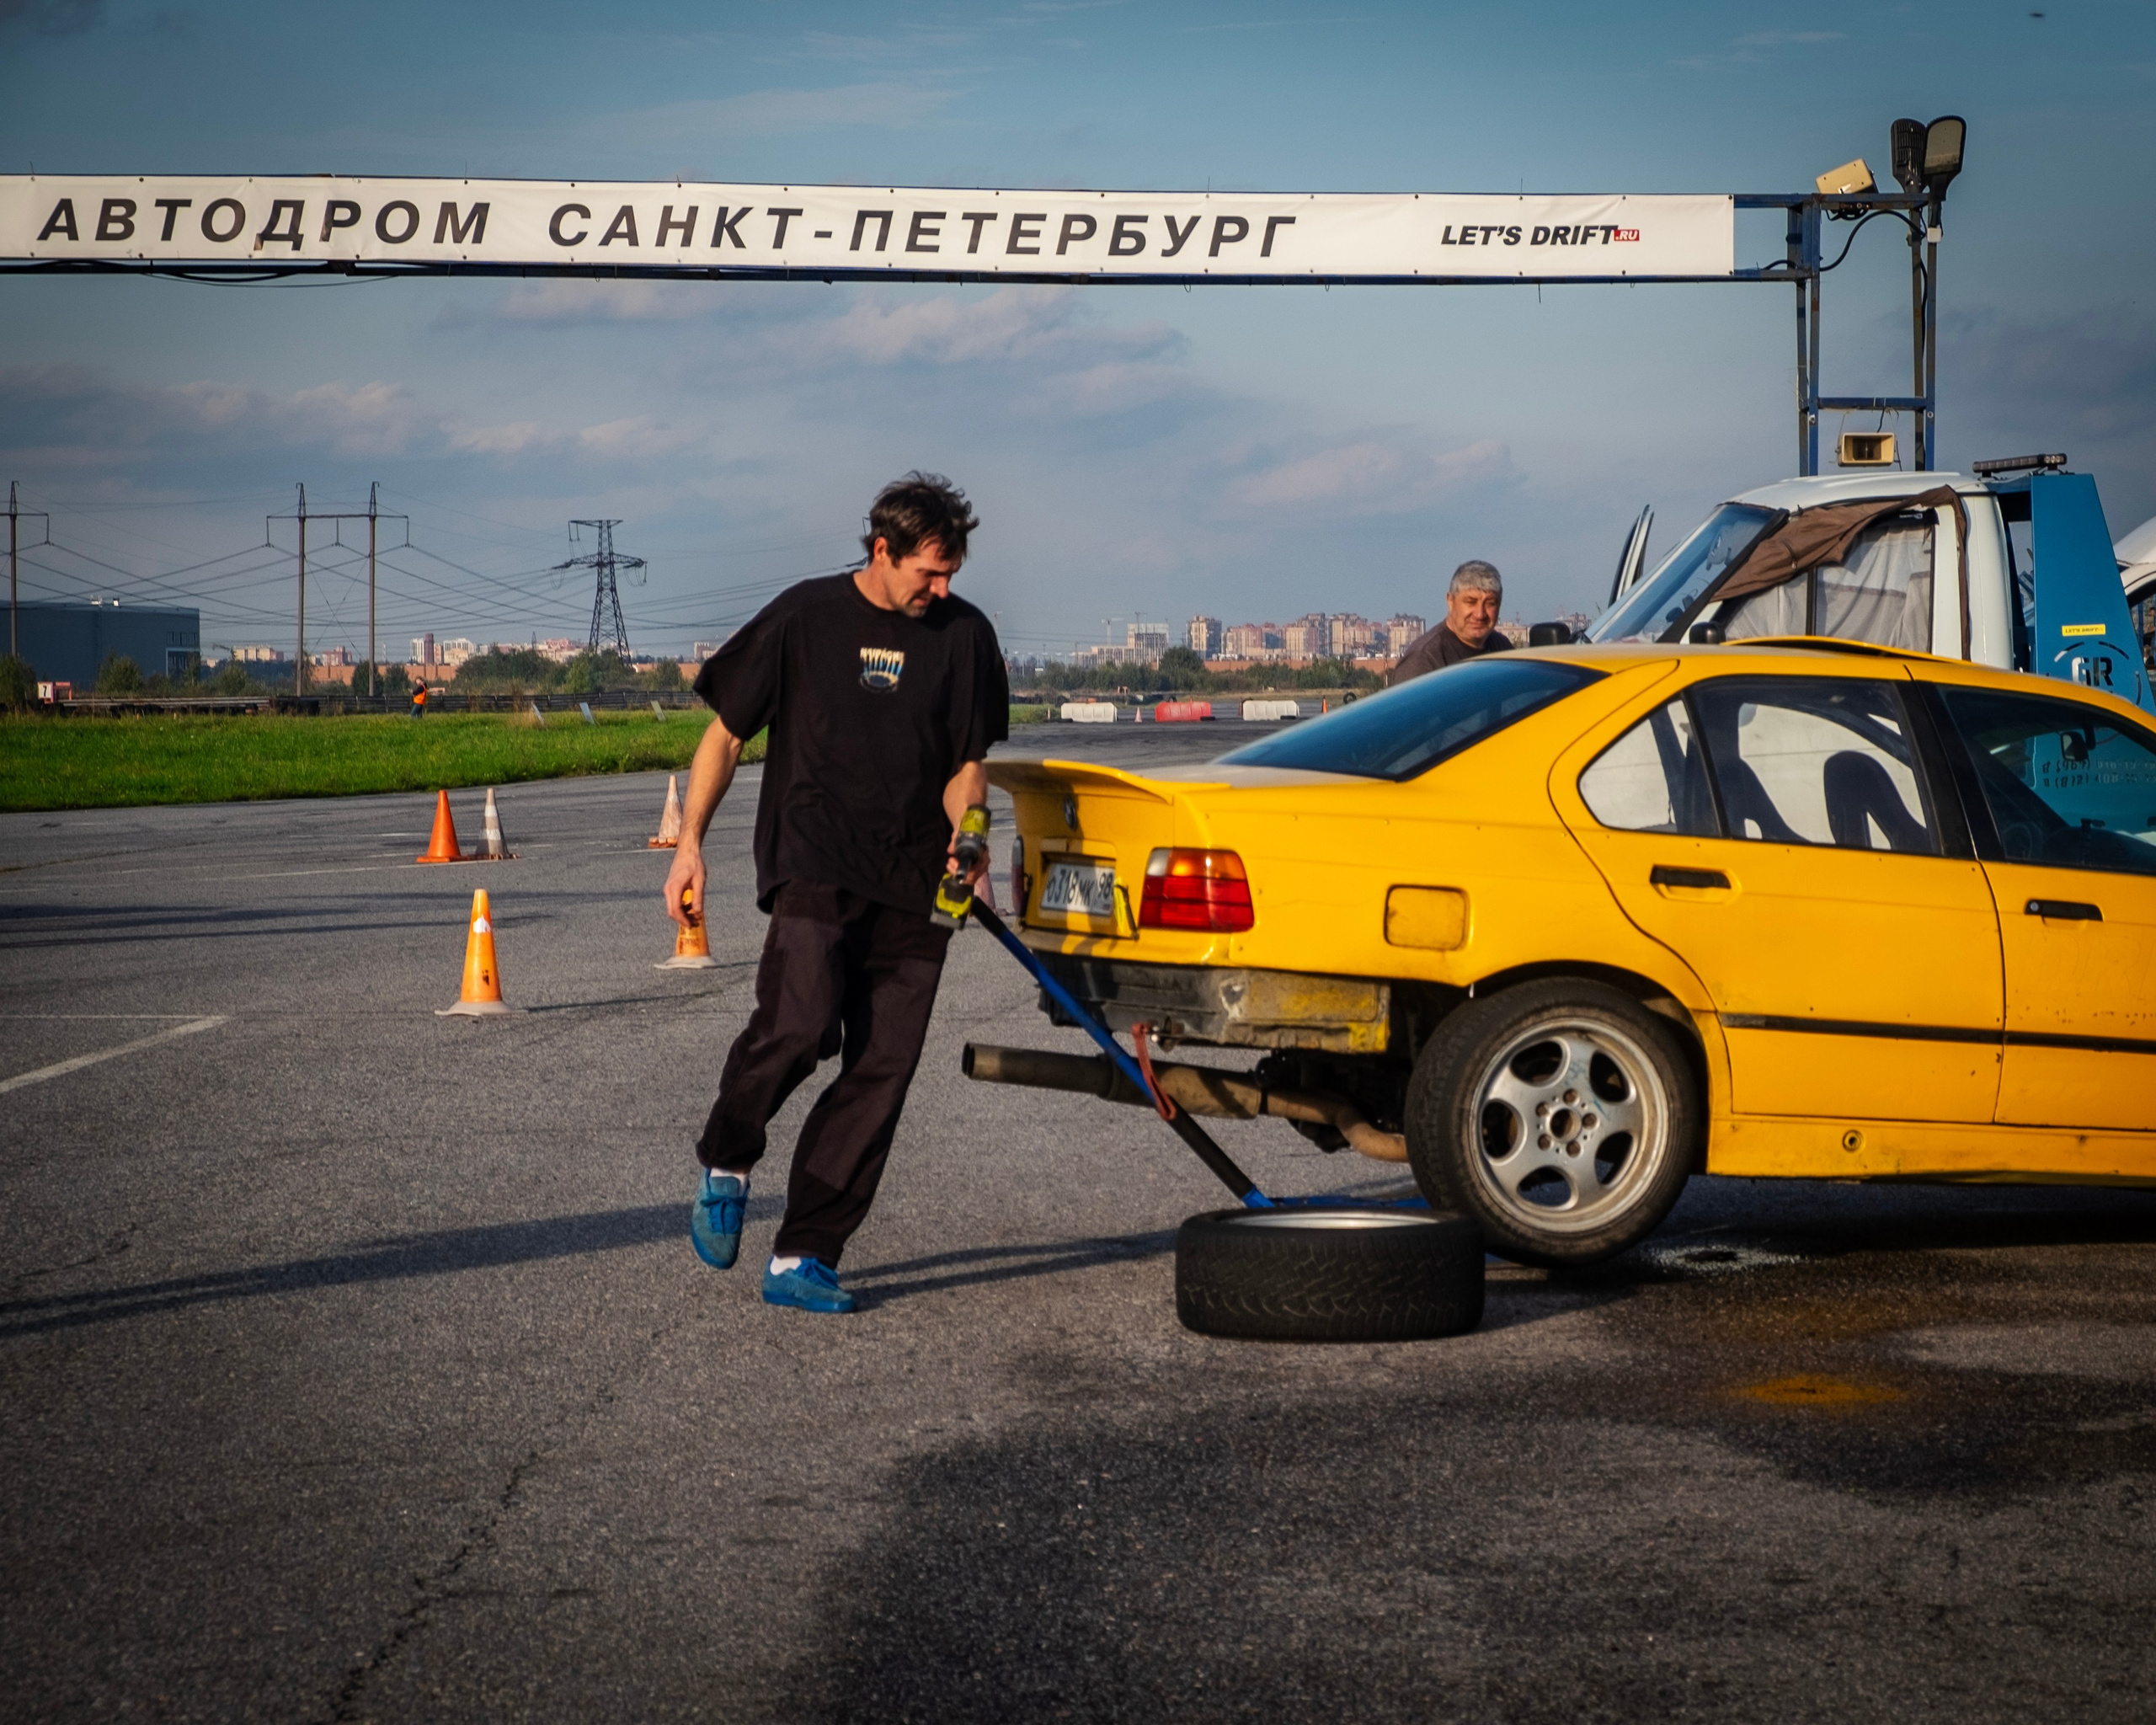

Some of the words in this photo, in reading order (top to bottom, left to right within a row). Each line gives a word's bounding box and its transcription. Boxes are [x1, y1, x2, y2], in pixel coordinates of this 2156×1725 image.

[36, 197, 490, 251] АВТОДРОМ
[548, 203, 1296, 258] САНКТ-ПЕТЕРБУРГ
[1441, 225, 1522, 246] LET'S
